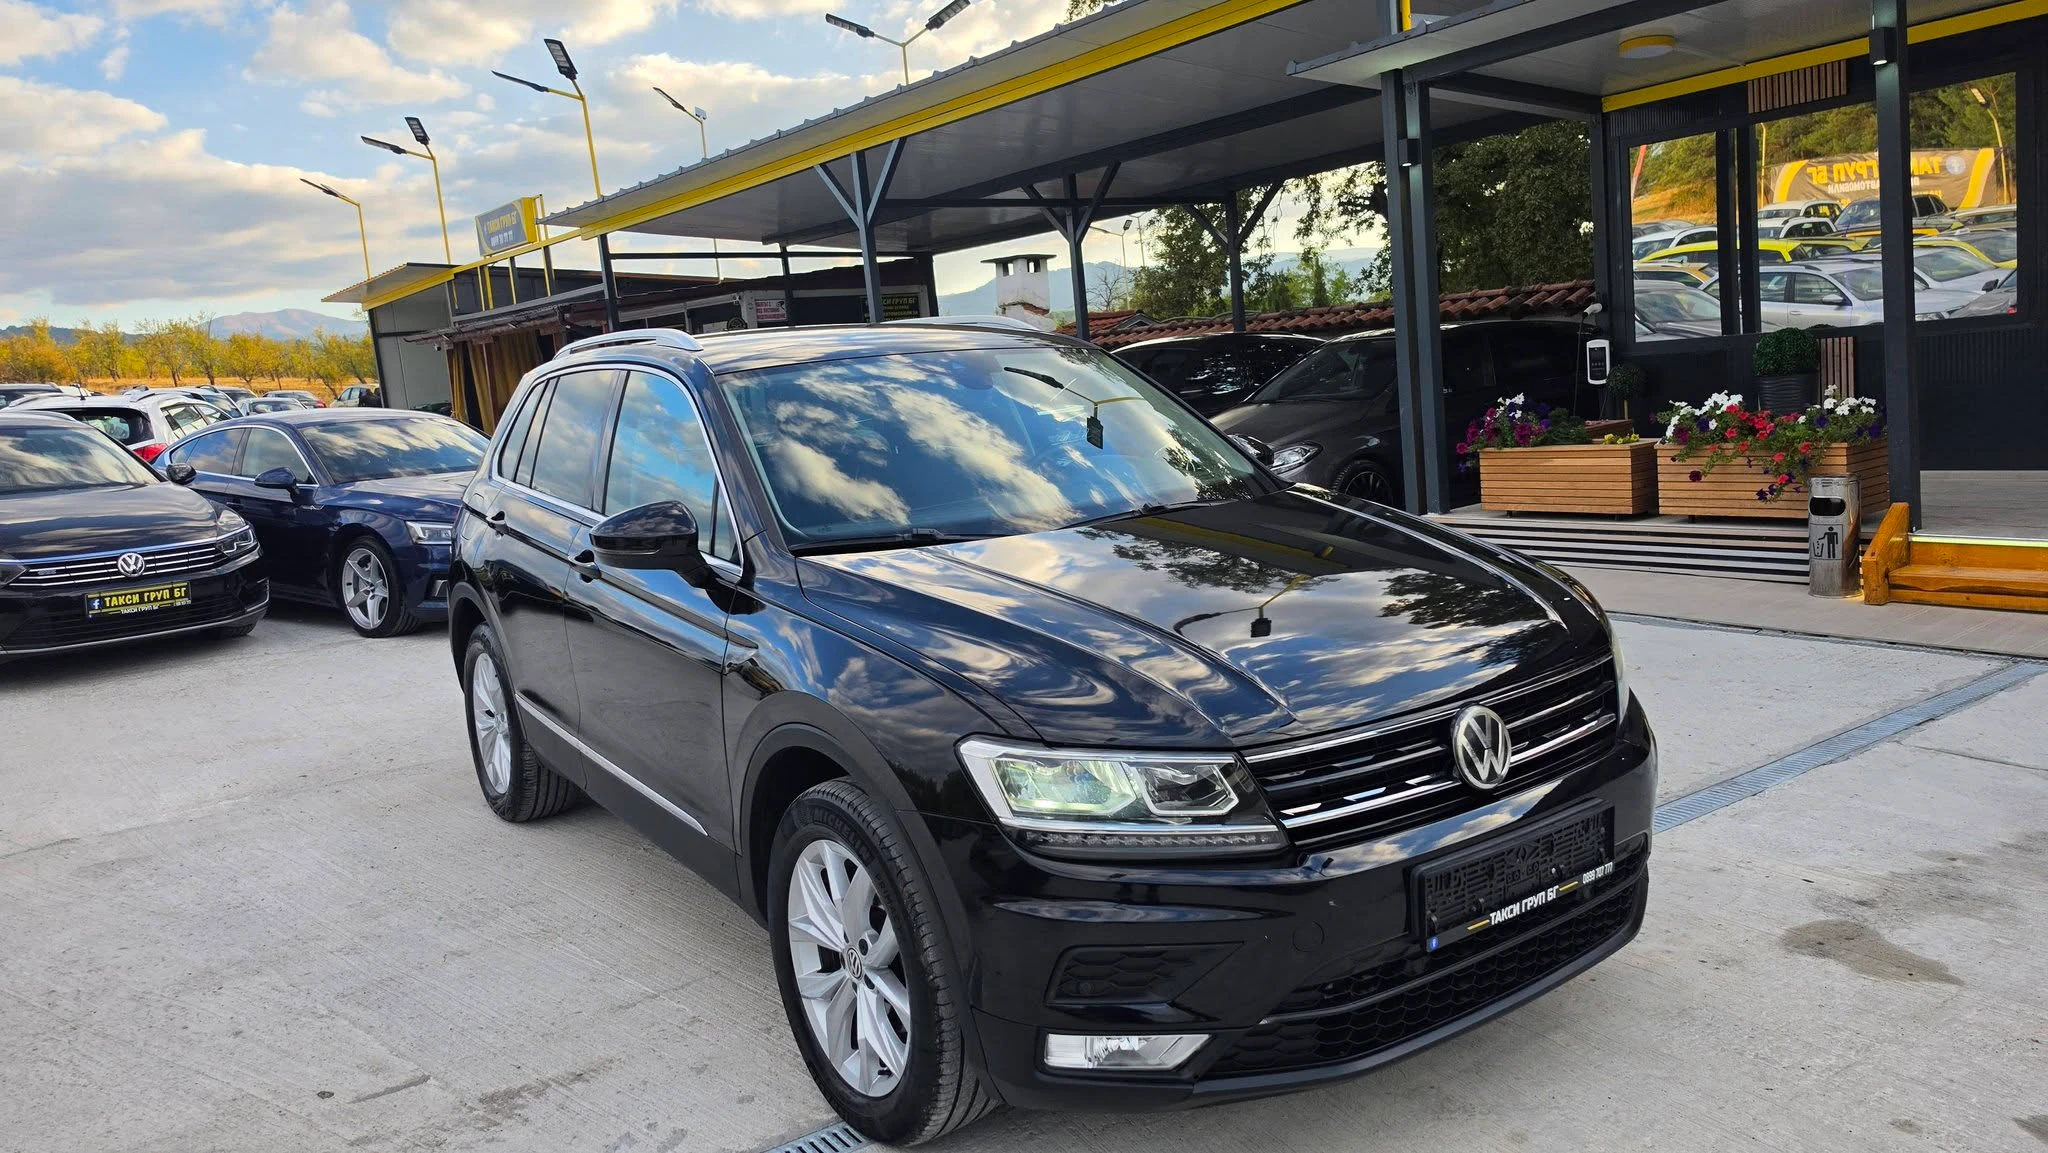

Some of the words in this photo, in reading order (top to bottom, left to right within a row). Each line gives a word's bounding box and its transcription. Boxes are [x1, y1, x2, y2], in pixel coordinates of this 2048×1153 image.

[104, 594, 140, 607] ТАКСИ
[144, 589, 170, 602] ГРУП
[174, 587, 186, 598] БГ
[1456, 708, 1509, 786] VW
[811, 806, 874, 867] MICHELIN
[1582, 869, 1596, 885] 0899
[1489, 901, 1520, 925] ТАКСИ
[1521, 890, 1546, 913] ГРУП
[1547, 885, 1560, 901] БГ
